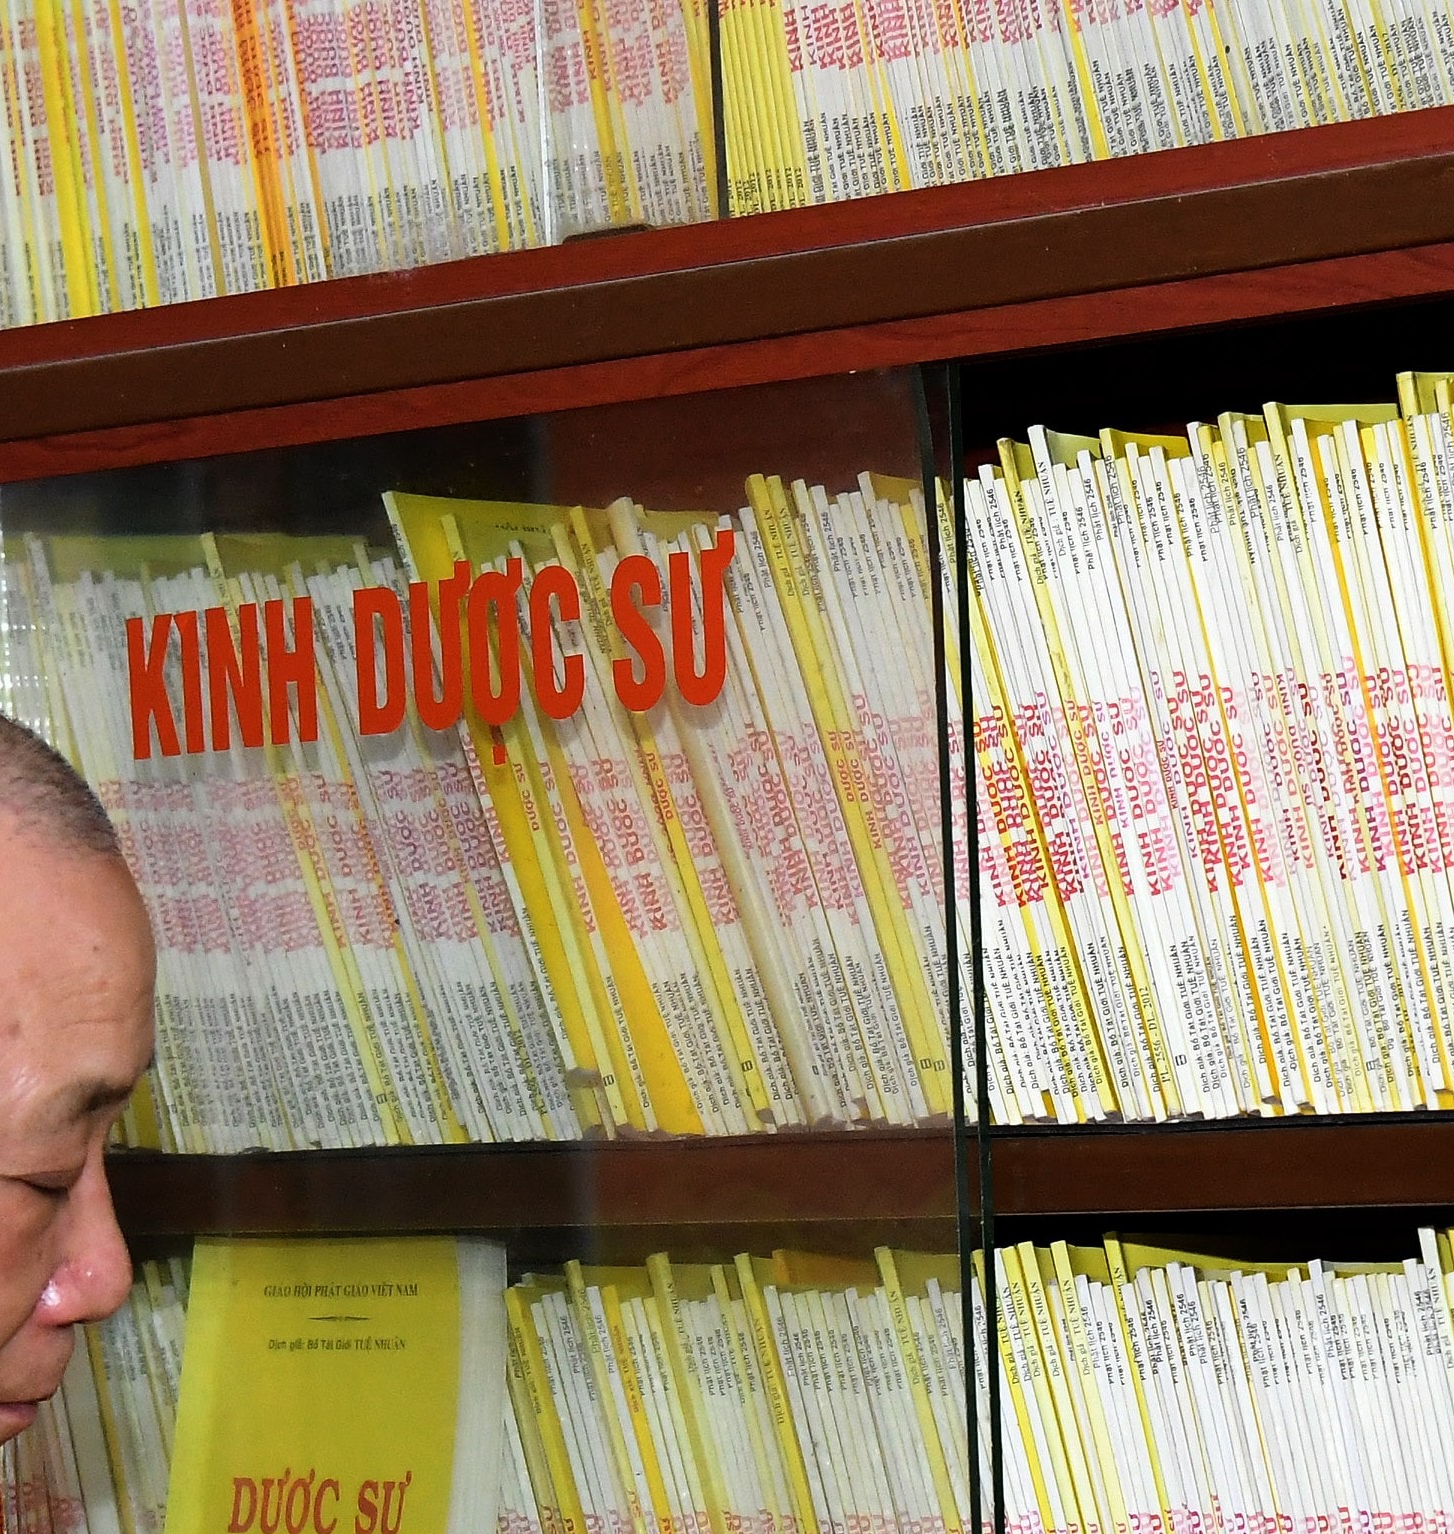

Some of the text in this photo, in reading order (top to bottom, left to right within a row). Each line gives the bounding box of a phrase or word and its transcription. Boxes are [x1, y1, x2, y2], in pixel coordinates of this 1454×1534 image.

[126, 530, 734, 765] KINH DƯỢC SƯ
[1277, 674, 1291, 716] KINH
[1087, 783, 1103, 826] KINH
[1138, 832, 1161, 896] KINH
[396, 1283, 418, 1296] NAM
